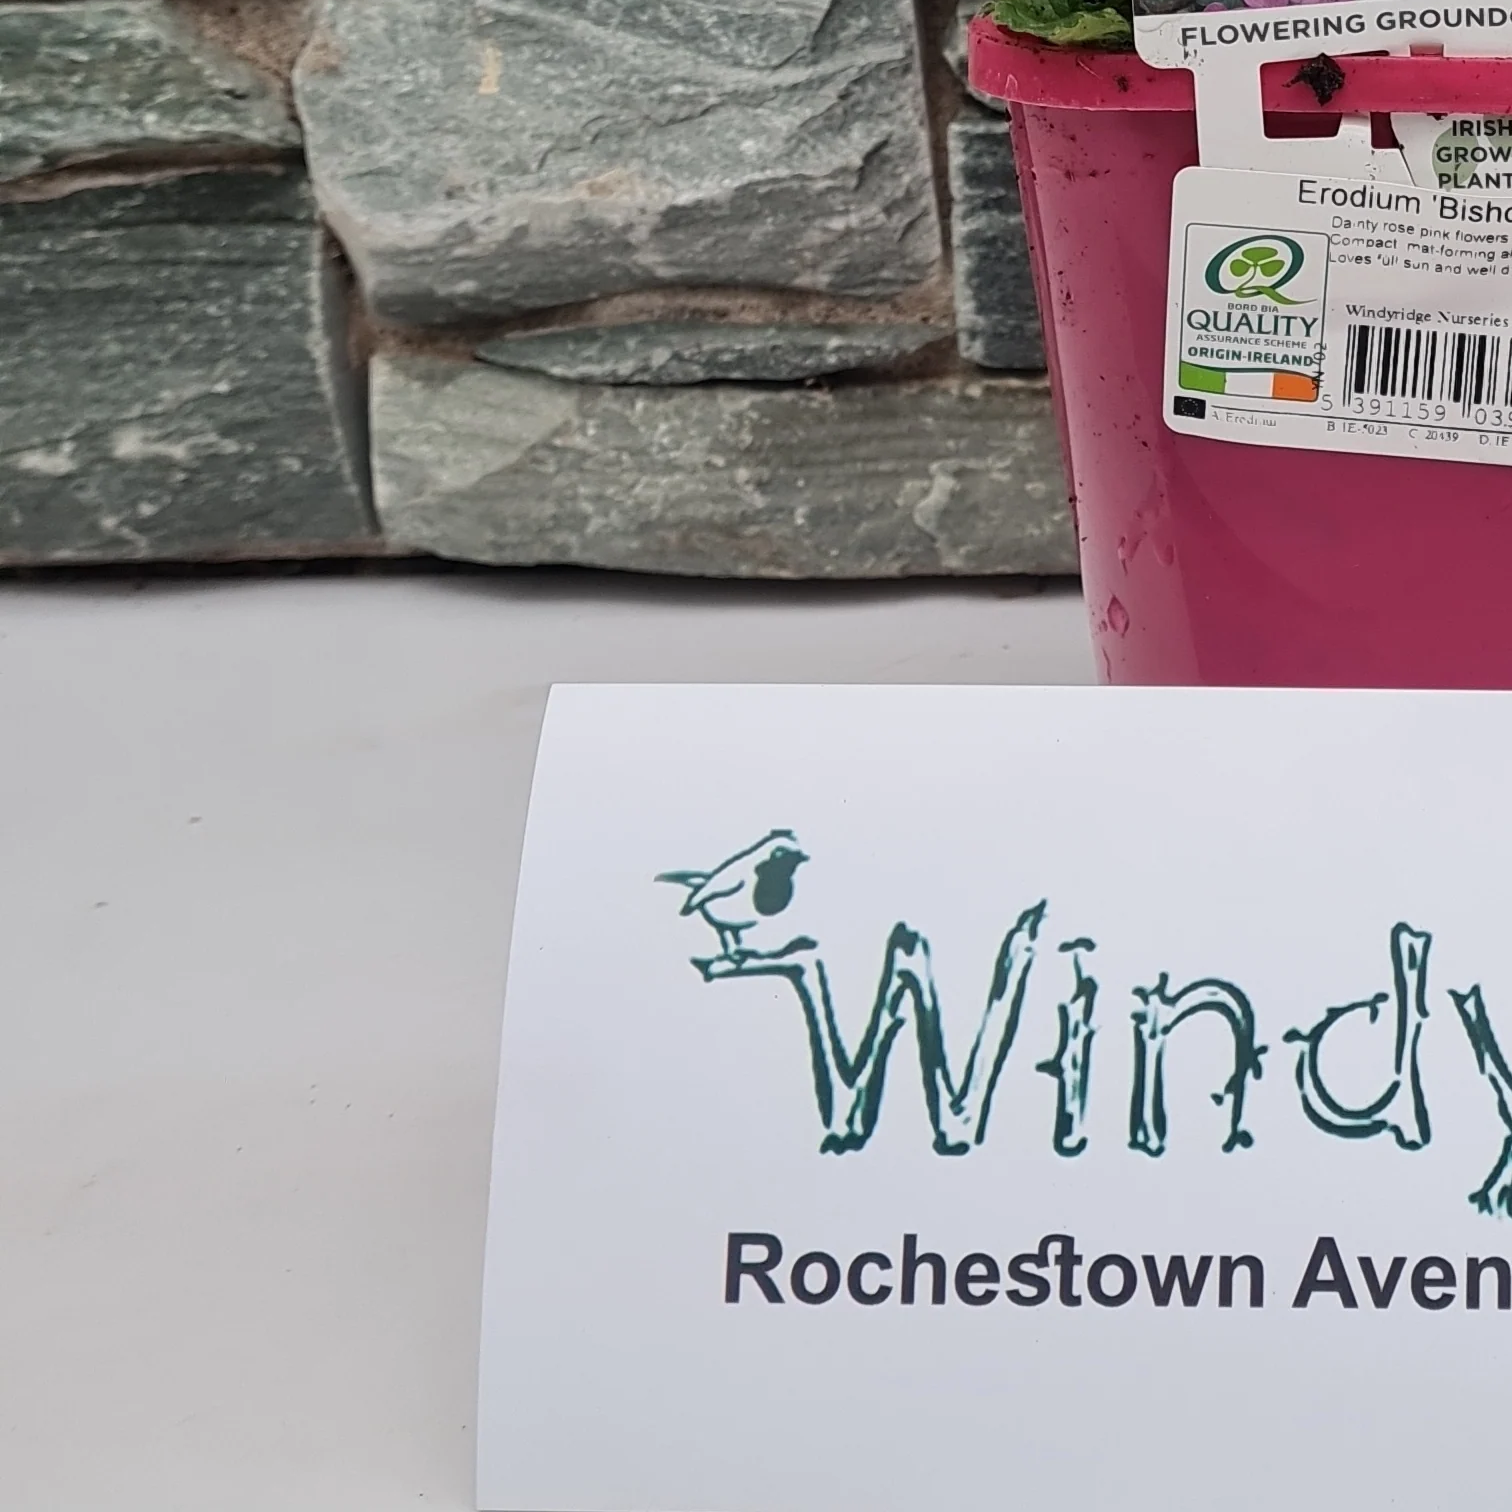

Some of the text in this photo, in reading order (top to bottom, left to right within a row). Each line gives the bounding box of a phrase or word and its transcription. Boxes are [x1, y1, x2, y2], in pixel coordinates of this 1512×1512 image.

[1180, 13, 1366, 47] FLOWERING
[1298, 178, 1421, 215] Erodium
[1383, 222, 1415, 235] rose
[1420, 227, 1451, 241] pink
[1455, 230, 1509, 243] flowers
[1330, 233, 1397, 249] Compact
[1407, 242, 1495, 262] mat-forming
[1329, 252, 1372, 265] Loves
[1403, 259, 1430, 271] sun
[1434, 263, 1462, 275] and
[1467, 265, 1496, 276] well
[1227, 302, 1280, 314] BORD BIA
[1346, 304, 1432, 326] Windyridge
[1186, 309, 1319, 338] QUALITY
[1196, 333, 1307, 350] ASSURANCE SCHEME
[1187, 346, 1314, 367] ORIGIN-IRELAND
[1352, 397, 1447, 422] 391159
[724, 1229, 1268, 1316] Rochestown
